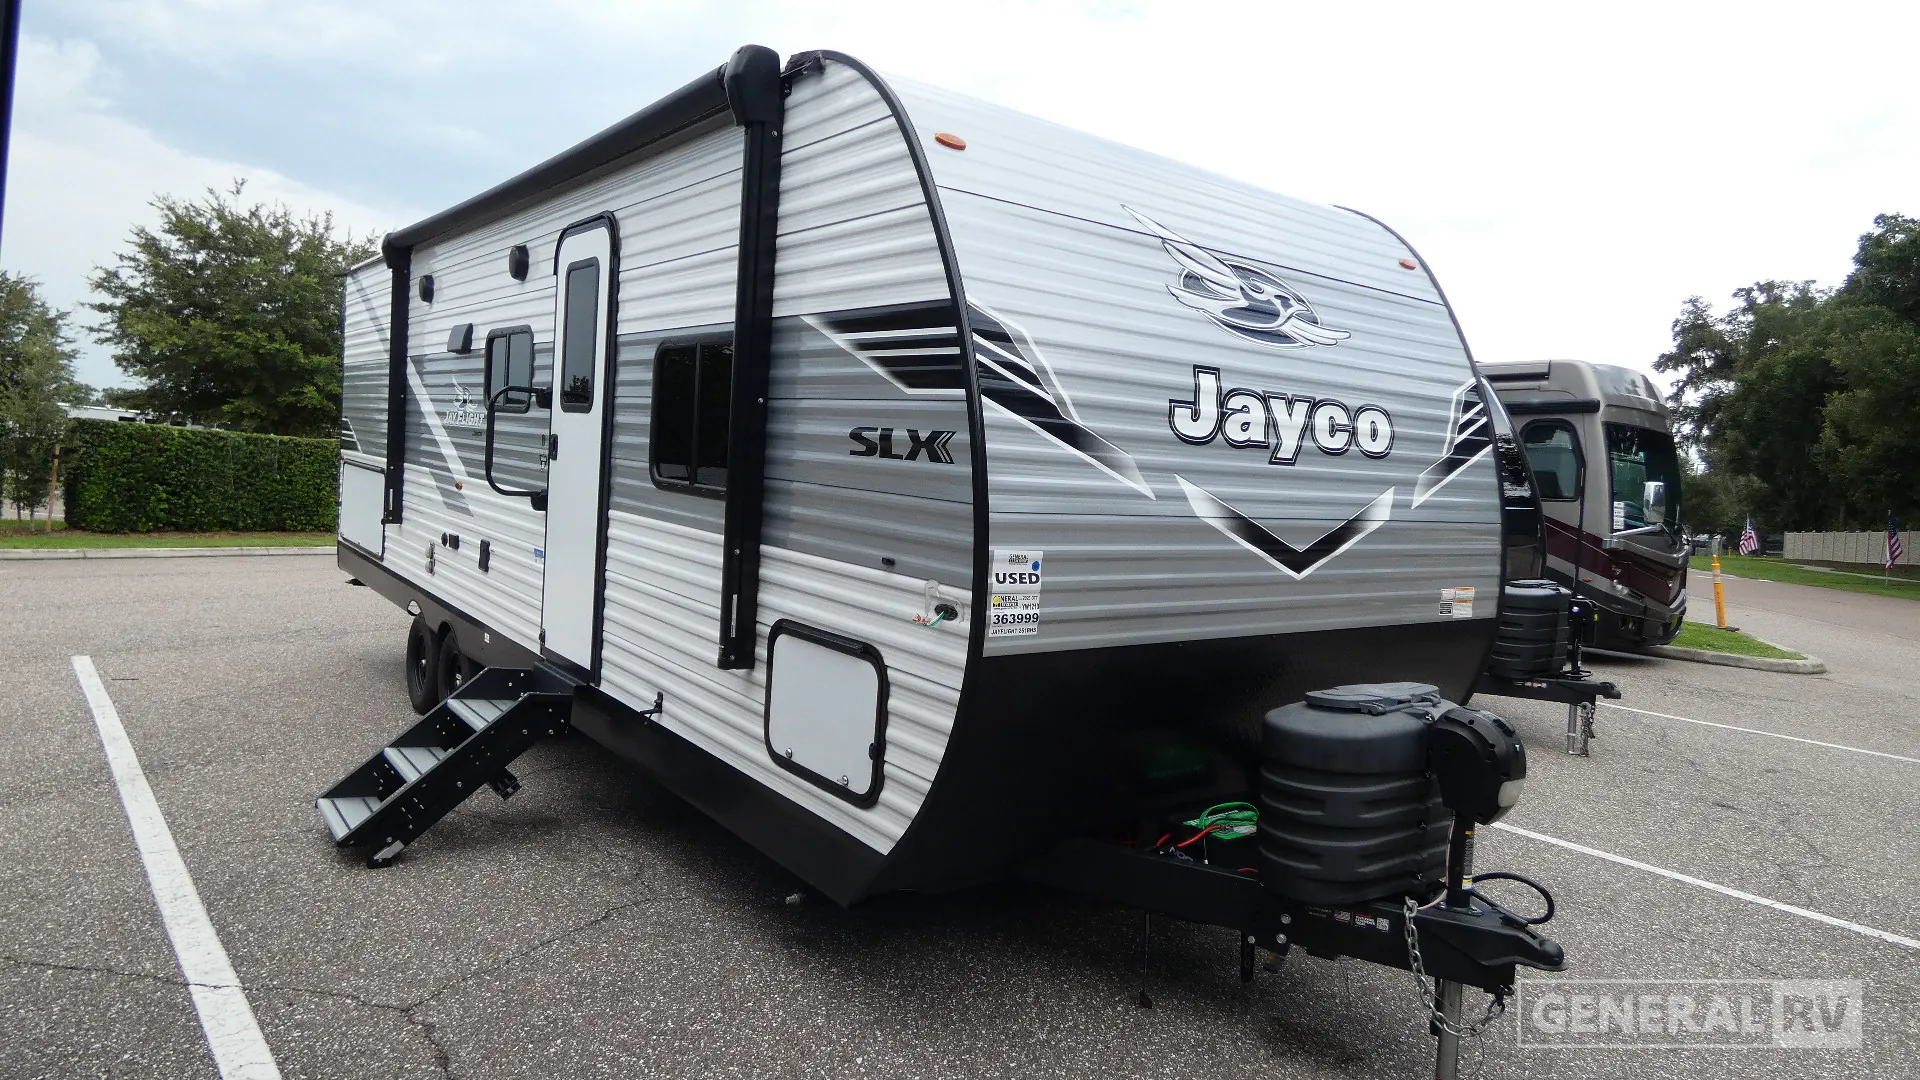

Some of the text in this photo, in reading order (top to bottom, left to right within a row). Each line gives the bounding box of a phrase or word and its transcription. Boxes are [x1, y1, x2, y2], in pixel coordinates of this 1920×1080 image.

[444, 411, 485, 427] JAY FLIGHT
[1168, 364, 1395, 466] Jayco
[849, 426, 957, 464] SLX
[995, 572, 1040, 584] USED
[993, 613, 1039, 624] 363999
